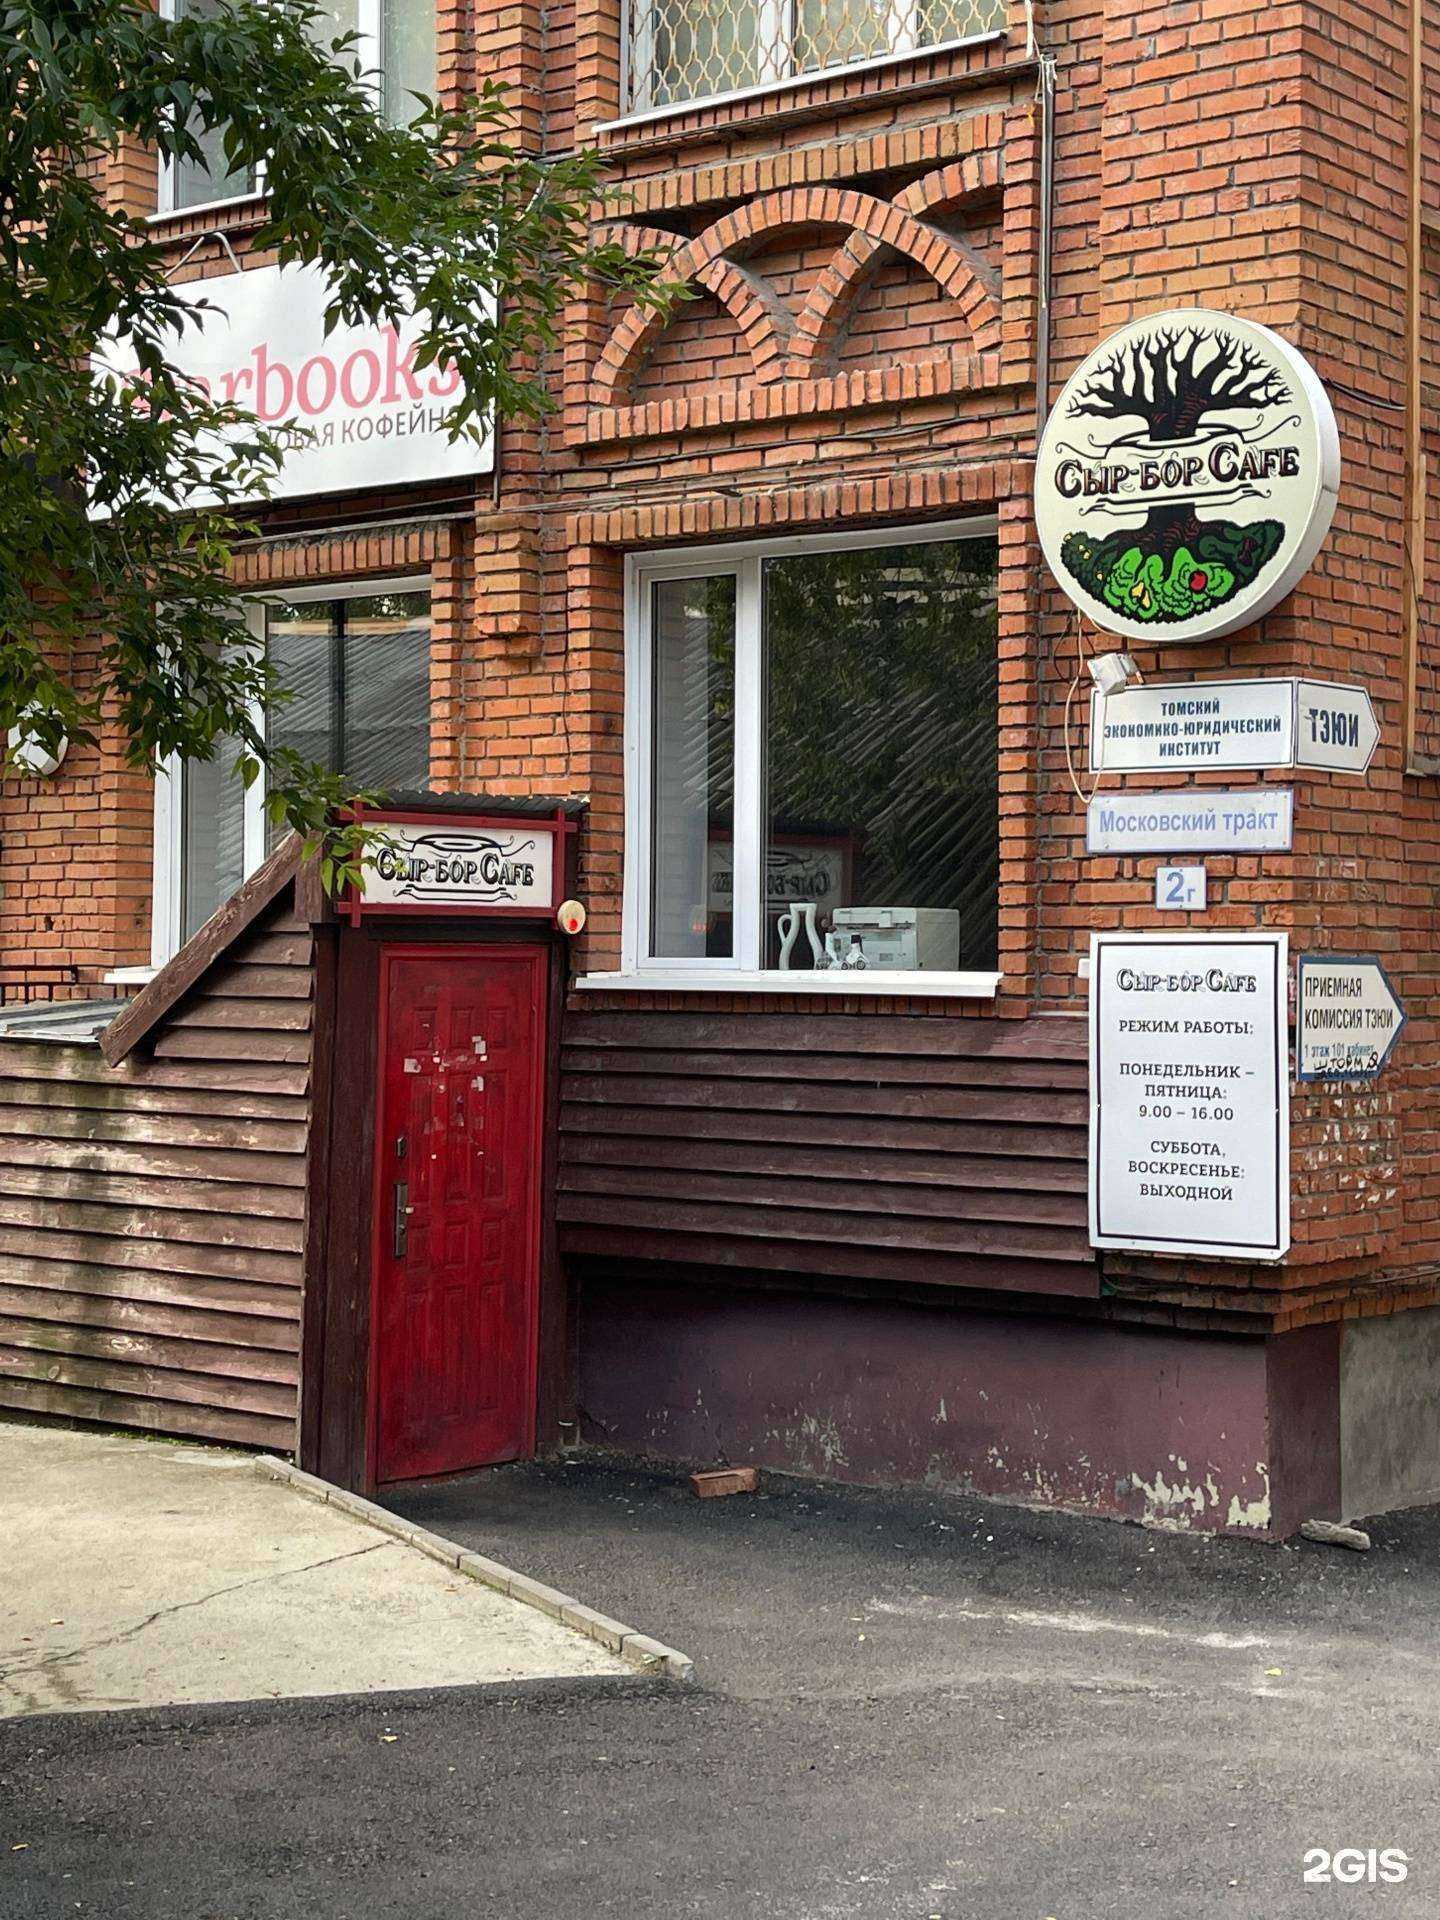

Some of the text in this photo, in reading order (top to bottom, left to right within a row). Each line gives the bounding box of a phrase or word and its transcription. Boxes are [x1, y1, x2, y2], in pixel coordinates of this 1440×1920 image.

[264, 402, 449, 452] ОВАЯ КОФЕЙН
[1208, 442, 1300, 482] CAFE
[1161, 697, 1220, 716] ТОМСКИЙ
[1104, 715, 1282, 738] ЭКОНОМИКО-ЮРИДИЧЕСКИЙ
[1309, 708, 1360, 748] ТЭЮИ
[1159, 741, 1221, 756] ИНСТИТУТ
[1100, 807, 1278, 835] Московский тракт
[1305, 977, 1362, 997] ПРИЕМНАЯ
[1119, 1020, 1179, 1033] РЕЖИМ
[1305, 1008, 1393, 1029] КОМИССИЯ ТЭЮИ
[1119, 1063, 1241, 1079] ПОНЕДЕЛЬНИК
[1144, 1084, 1227, 1100] ПЯТНИЦА:
[1139, 1104, 1172, 1118] 9.00
[1191, 1106, 1234, 1120] 16.00
[1150, 1140, 1226, 1157] СУББОТА,
[1128, 1160, 1245, 1179] ВОСКРЕСЕНЬЕ:
[1140, 1183, 1233, 1201] ВЫХОДНОЙ
